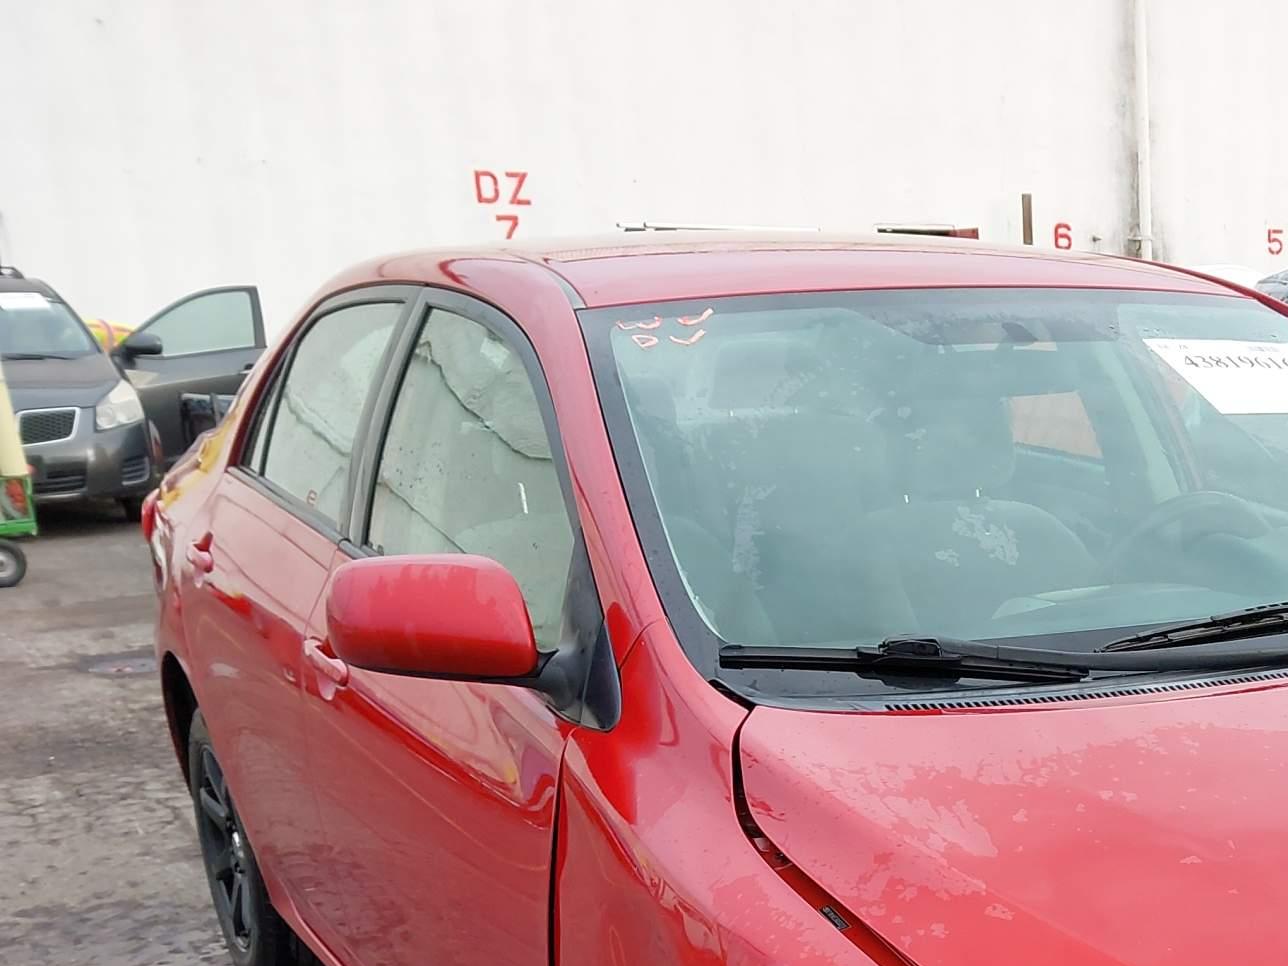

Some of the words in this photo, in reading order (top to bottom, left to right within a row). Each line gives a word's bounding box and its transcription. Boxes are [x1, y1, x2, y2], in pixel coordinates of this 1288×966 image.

[474, 170, 531, 205] DZ
[495, 214, 519, 240] 7
[1054, 222, 1072, 250] 6
[1267, 228, 1284, 255] 5
